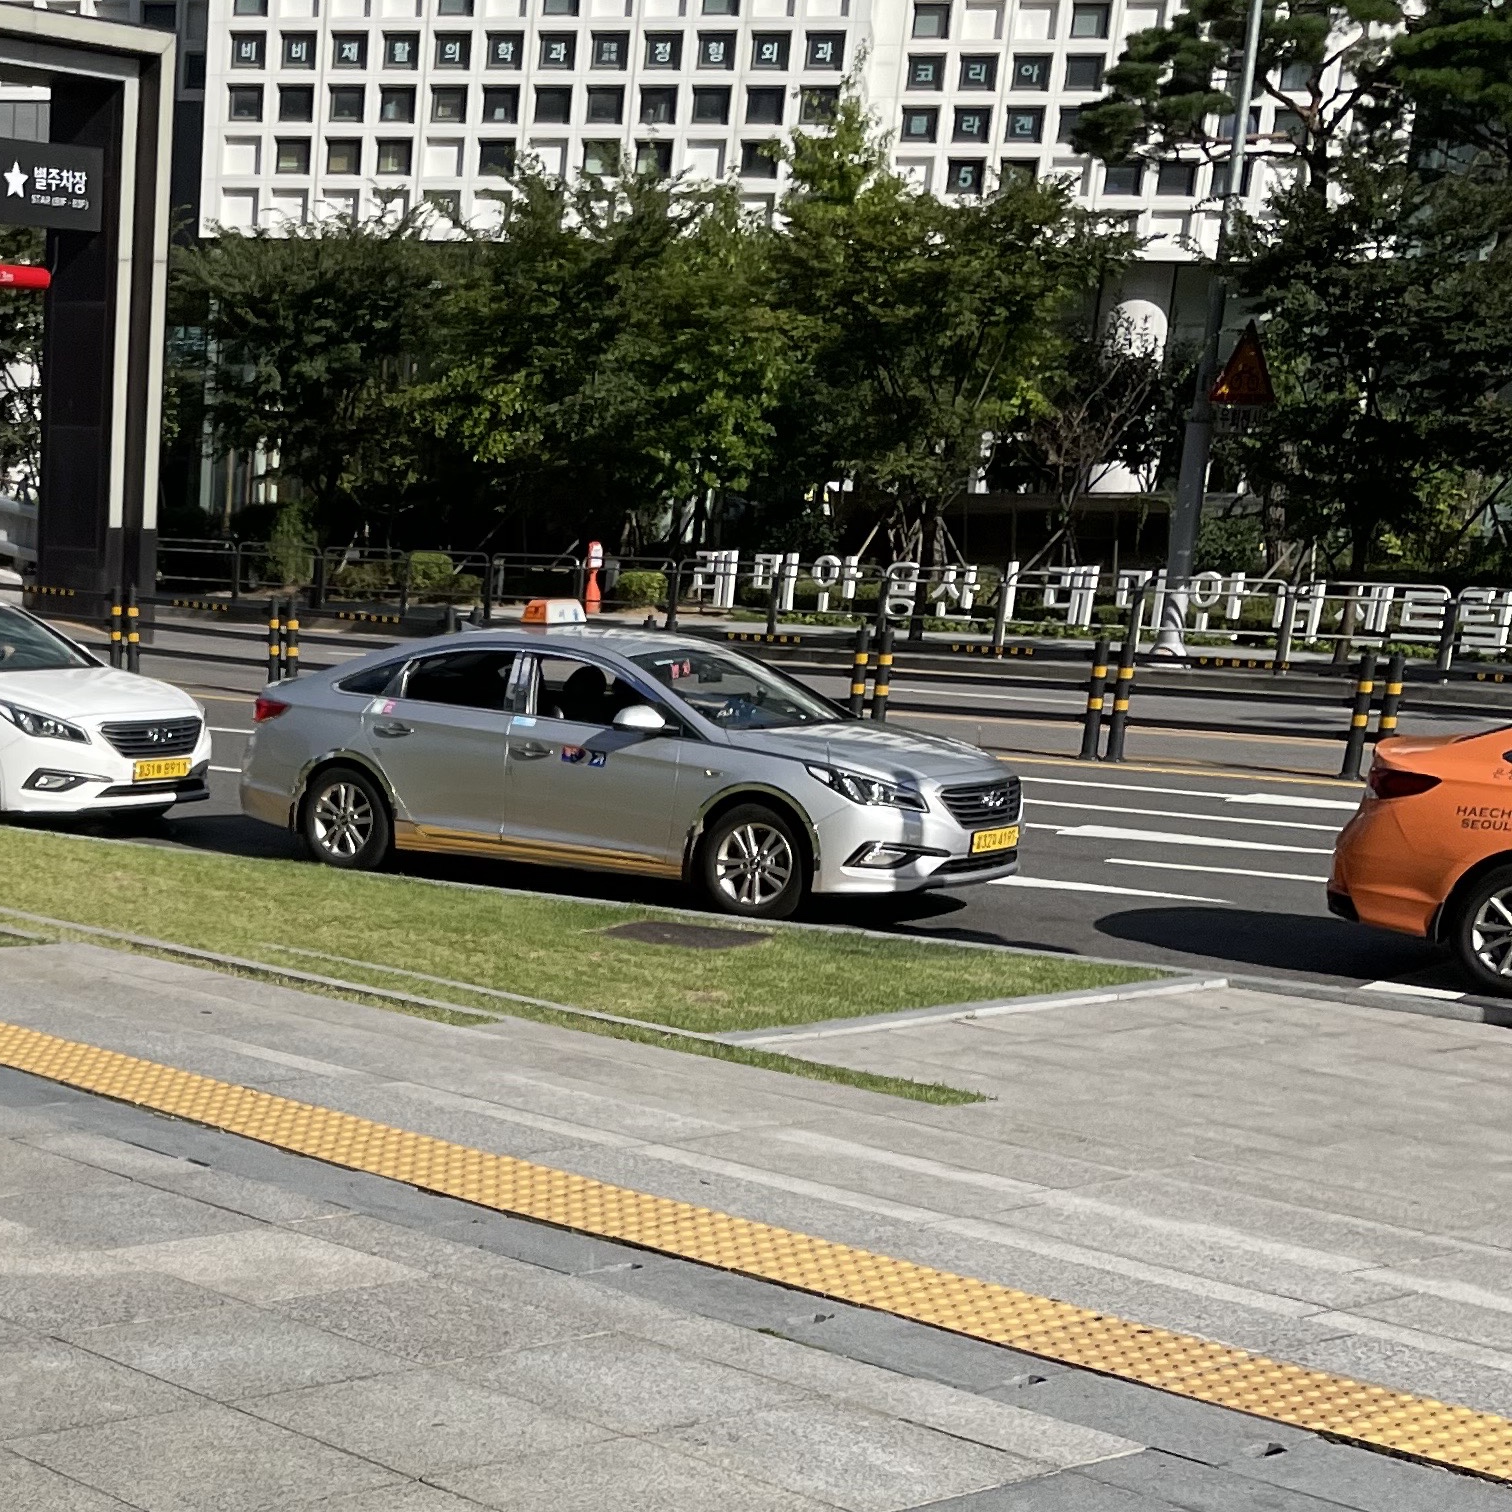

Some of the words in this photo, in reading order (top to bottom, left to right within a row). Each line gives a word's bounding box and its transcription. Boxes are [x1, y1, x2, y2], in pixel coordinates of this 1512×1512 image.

[654, 41, 834, 62] 정형외과
[915, 64, 1040, 83] 코리아
[33, 166, 88, 195] 별주차장
[31, 194, 51, 205] STAR
[1455, 805, 1512, 819] HAECH
[1461, 817, 1512, 832] SEOUL
